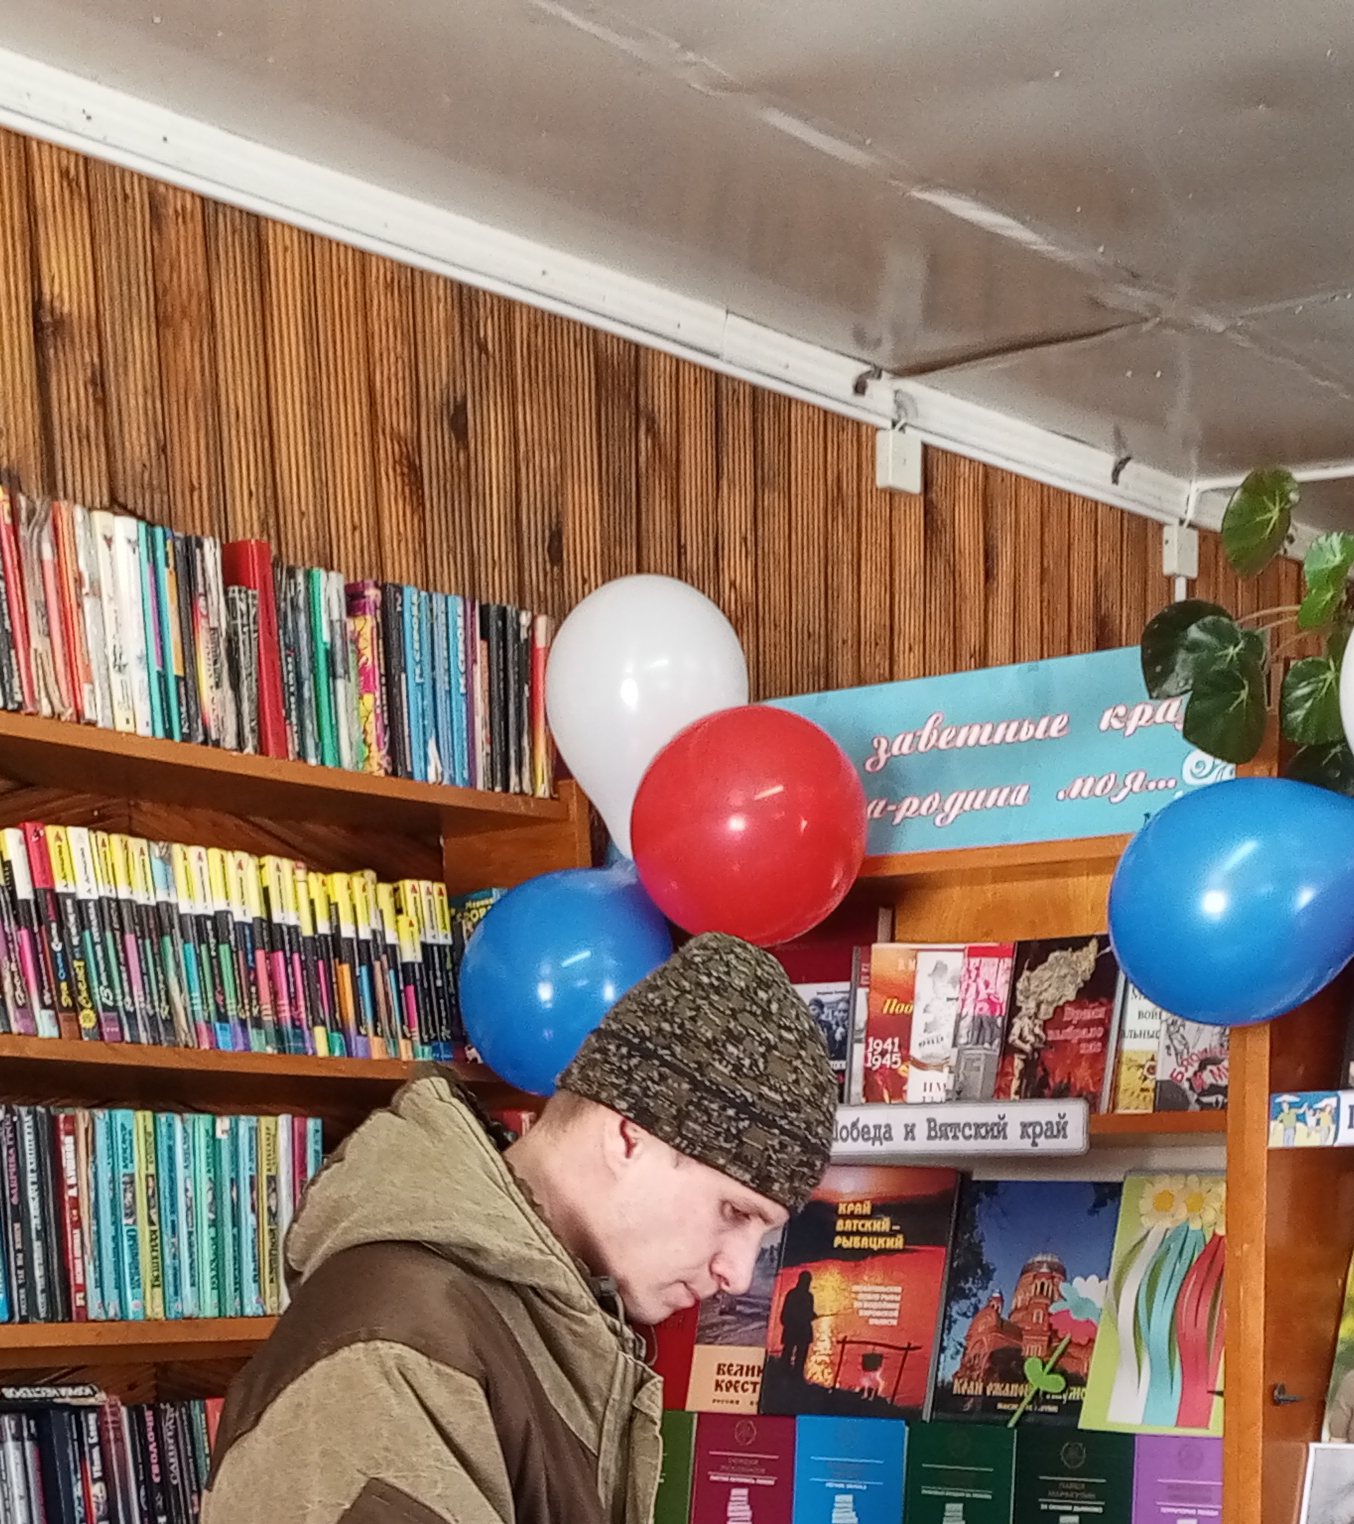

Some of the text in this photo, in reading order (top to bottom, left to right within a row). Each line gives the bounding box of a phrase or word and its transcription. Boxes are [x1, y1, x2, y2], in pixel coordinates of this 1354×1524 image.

[864, 711, 1070, 773] заветные
[867, 1037, 900, 1053] 1941
[865, 1052, 902, 1071] 1945
[904, 1120, 916, 1140] и
[925, 1113, 1009, 1142] Вятский
[1020, 1113, 1070, 1145] край
